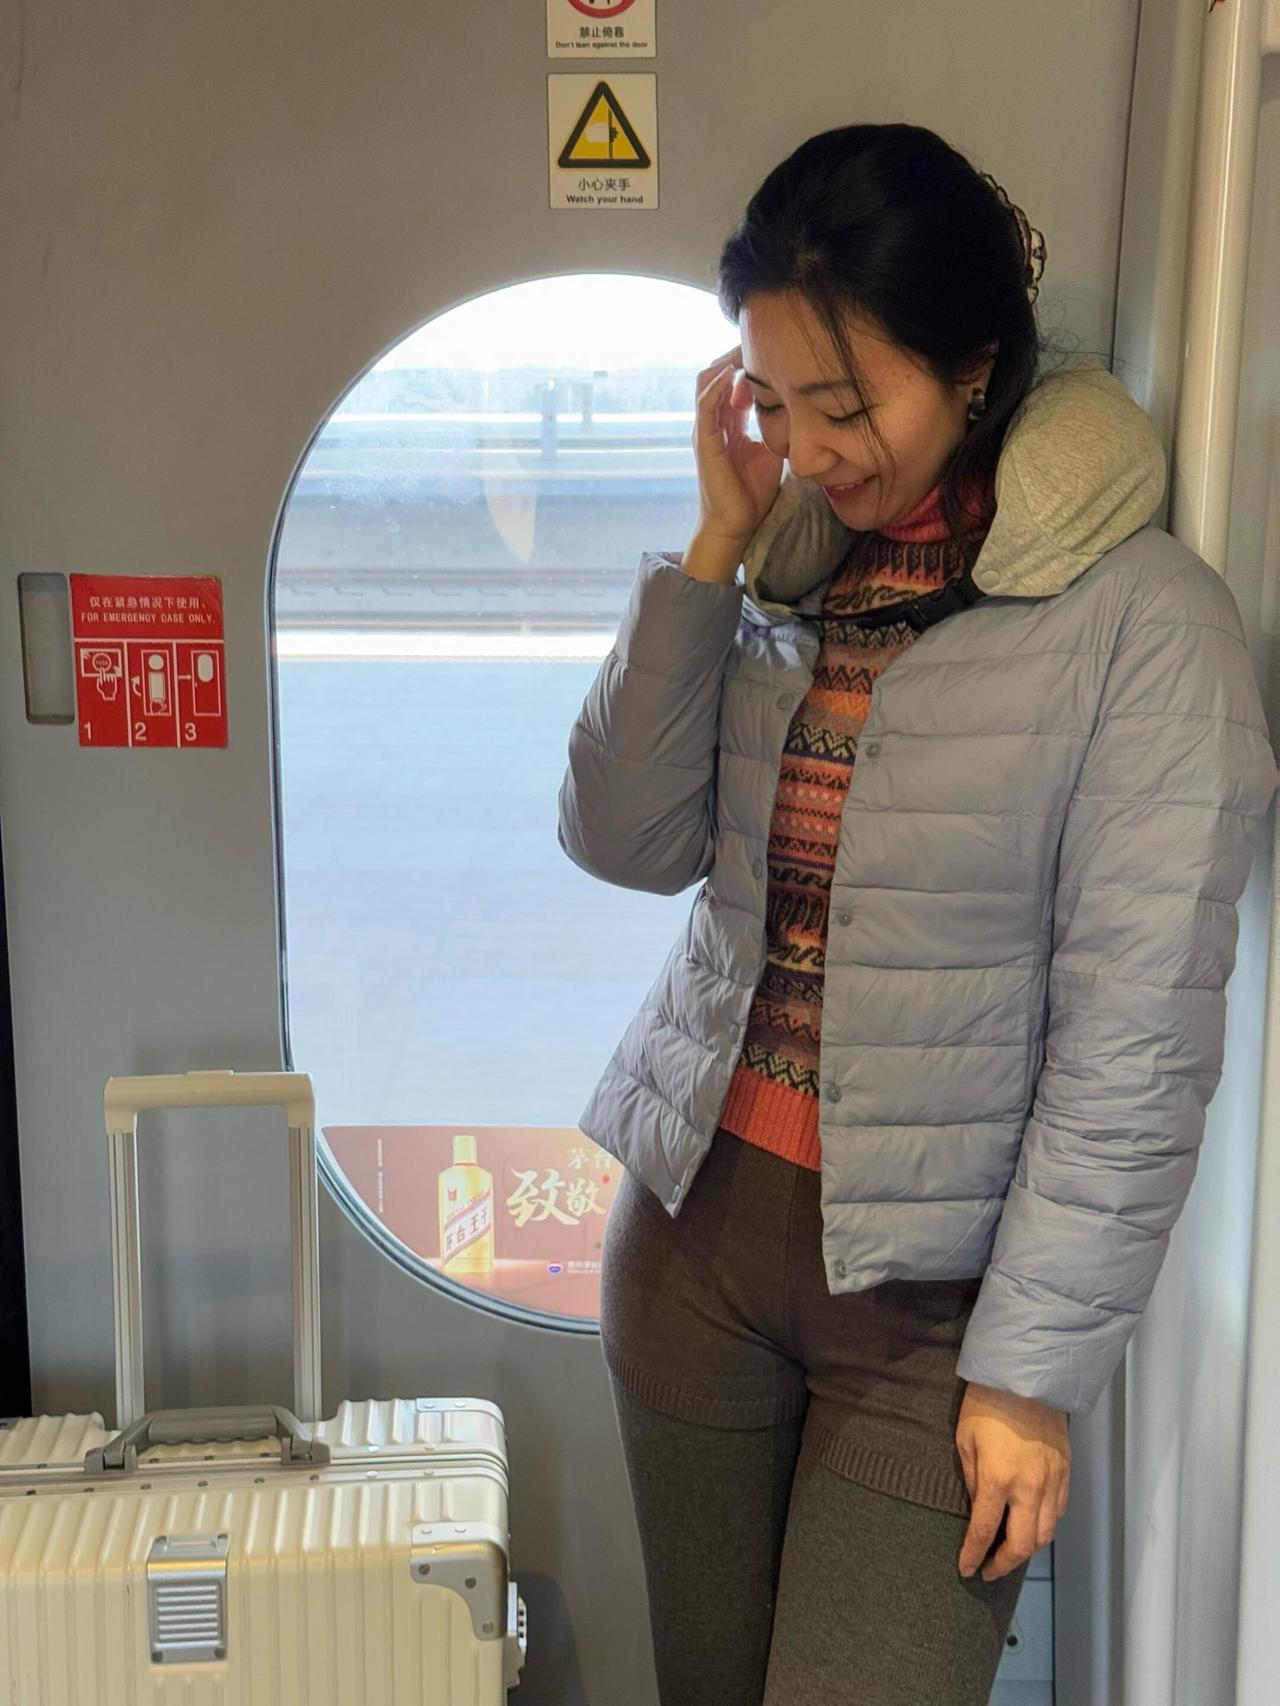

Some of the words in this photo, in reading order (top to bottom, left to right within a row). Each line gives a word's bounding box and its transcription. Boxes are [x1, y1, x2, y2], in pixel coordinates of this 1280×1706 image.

[580, 26, 624, 39] 禁止倚靠
[592, 41, 617, 50] against
[578, 178, 631, 191] 小心夹手
[566, 194, 594, 203] Watch
[596, 195, 618, 205] your
[620, 195, 643, 204] hand
[81, 612, 99, 623] FOR
[103, 612, 156, 623] EMERGENCY
[160, 613, 184, 623] CASE
[84, 722, 92, 741] 1
[135, 722, 147, 741] 2
[185, 722, 197, 741] 3
[506, 1168, 607, 1228] 致敬
